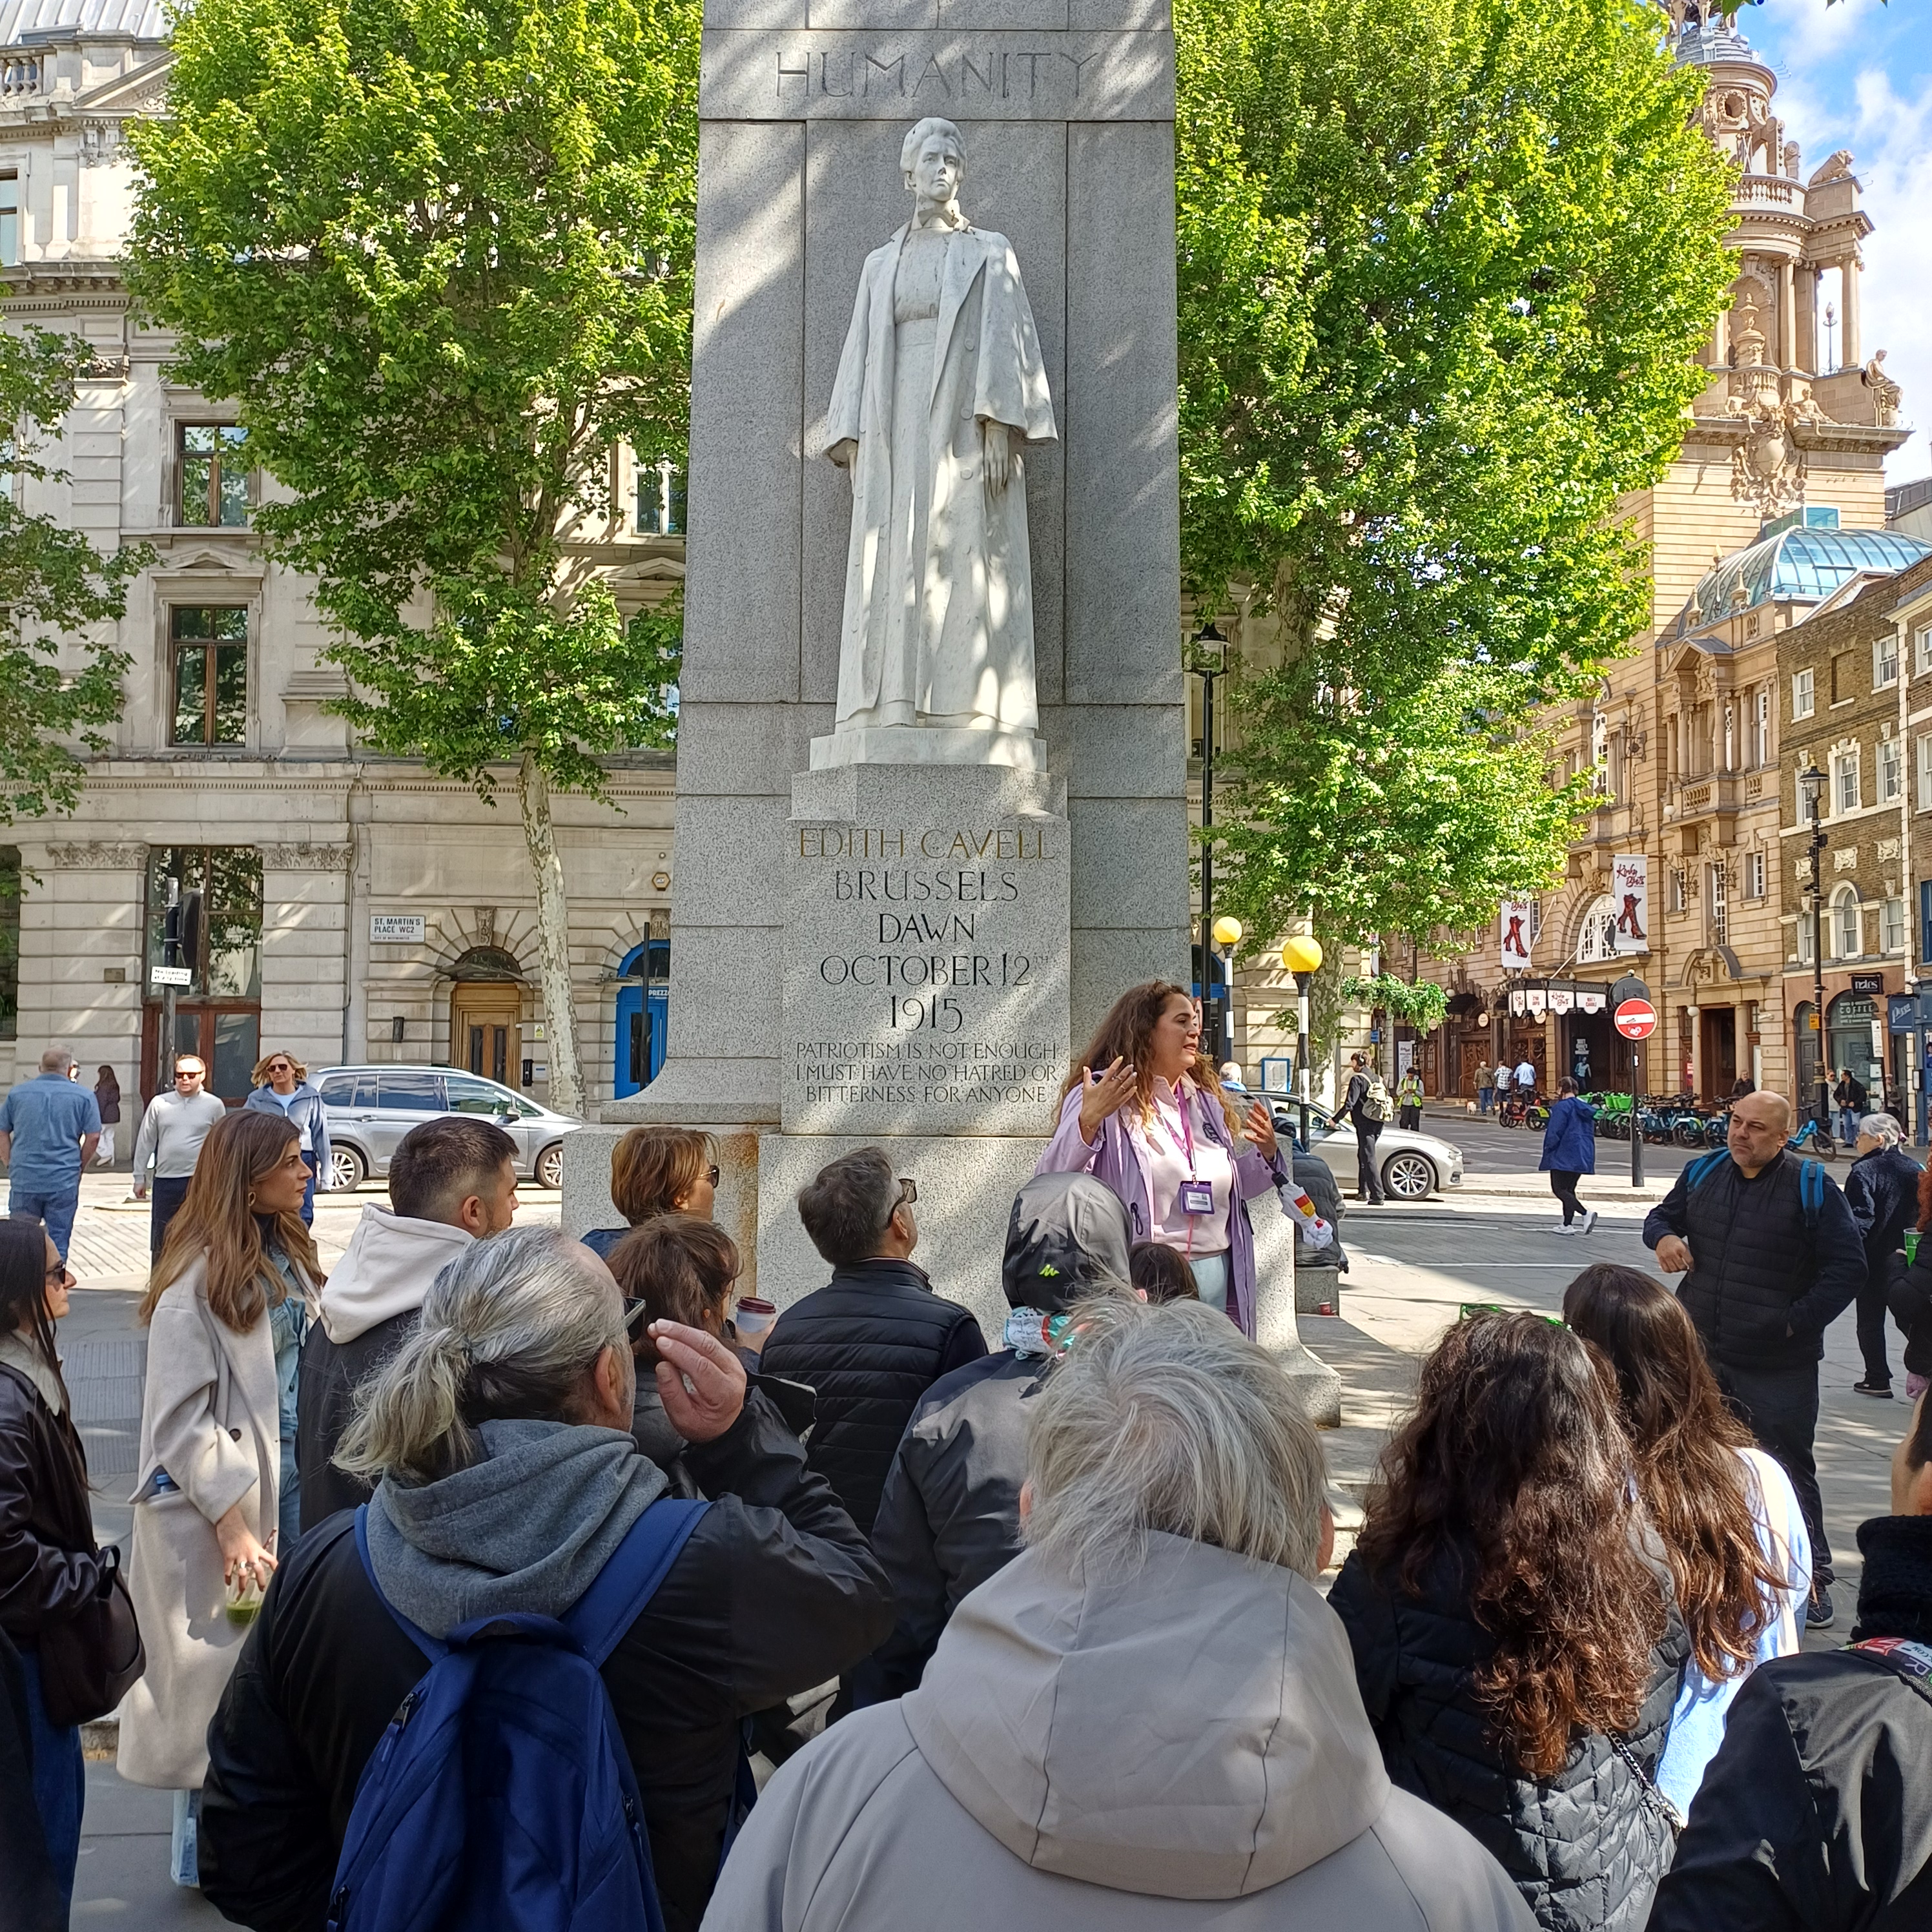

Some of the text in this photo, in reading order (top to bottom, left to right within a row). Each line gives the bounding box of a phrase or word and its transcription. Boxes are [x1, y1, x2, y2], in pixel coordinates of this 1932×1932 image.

[776, 51, 1098, 98] HUMANITY
[800, 828, 1058, 859] EDITH CAVELL
[836, 870, 1018, 901] BRUSSELS
[879, 913, 974, 943] DAWN
[820, 955, 992, 986] OCTOBER
[890, 994, 963, 1033] 1915
[1840, 1005, 1873, 1014] COFFEE
[797, 1042, 1056, 1059] PATRIOTISM IS NOT ENOUGH
[797, 1064, 1057, 1081] I MUST HAVE NO HATRED OR
[807, 1086, 1047, 1102] BITTERNESS FOR ANYONE
